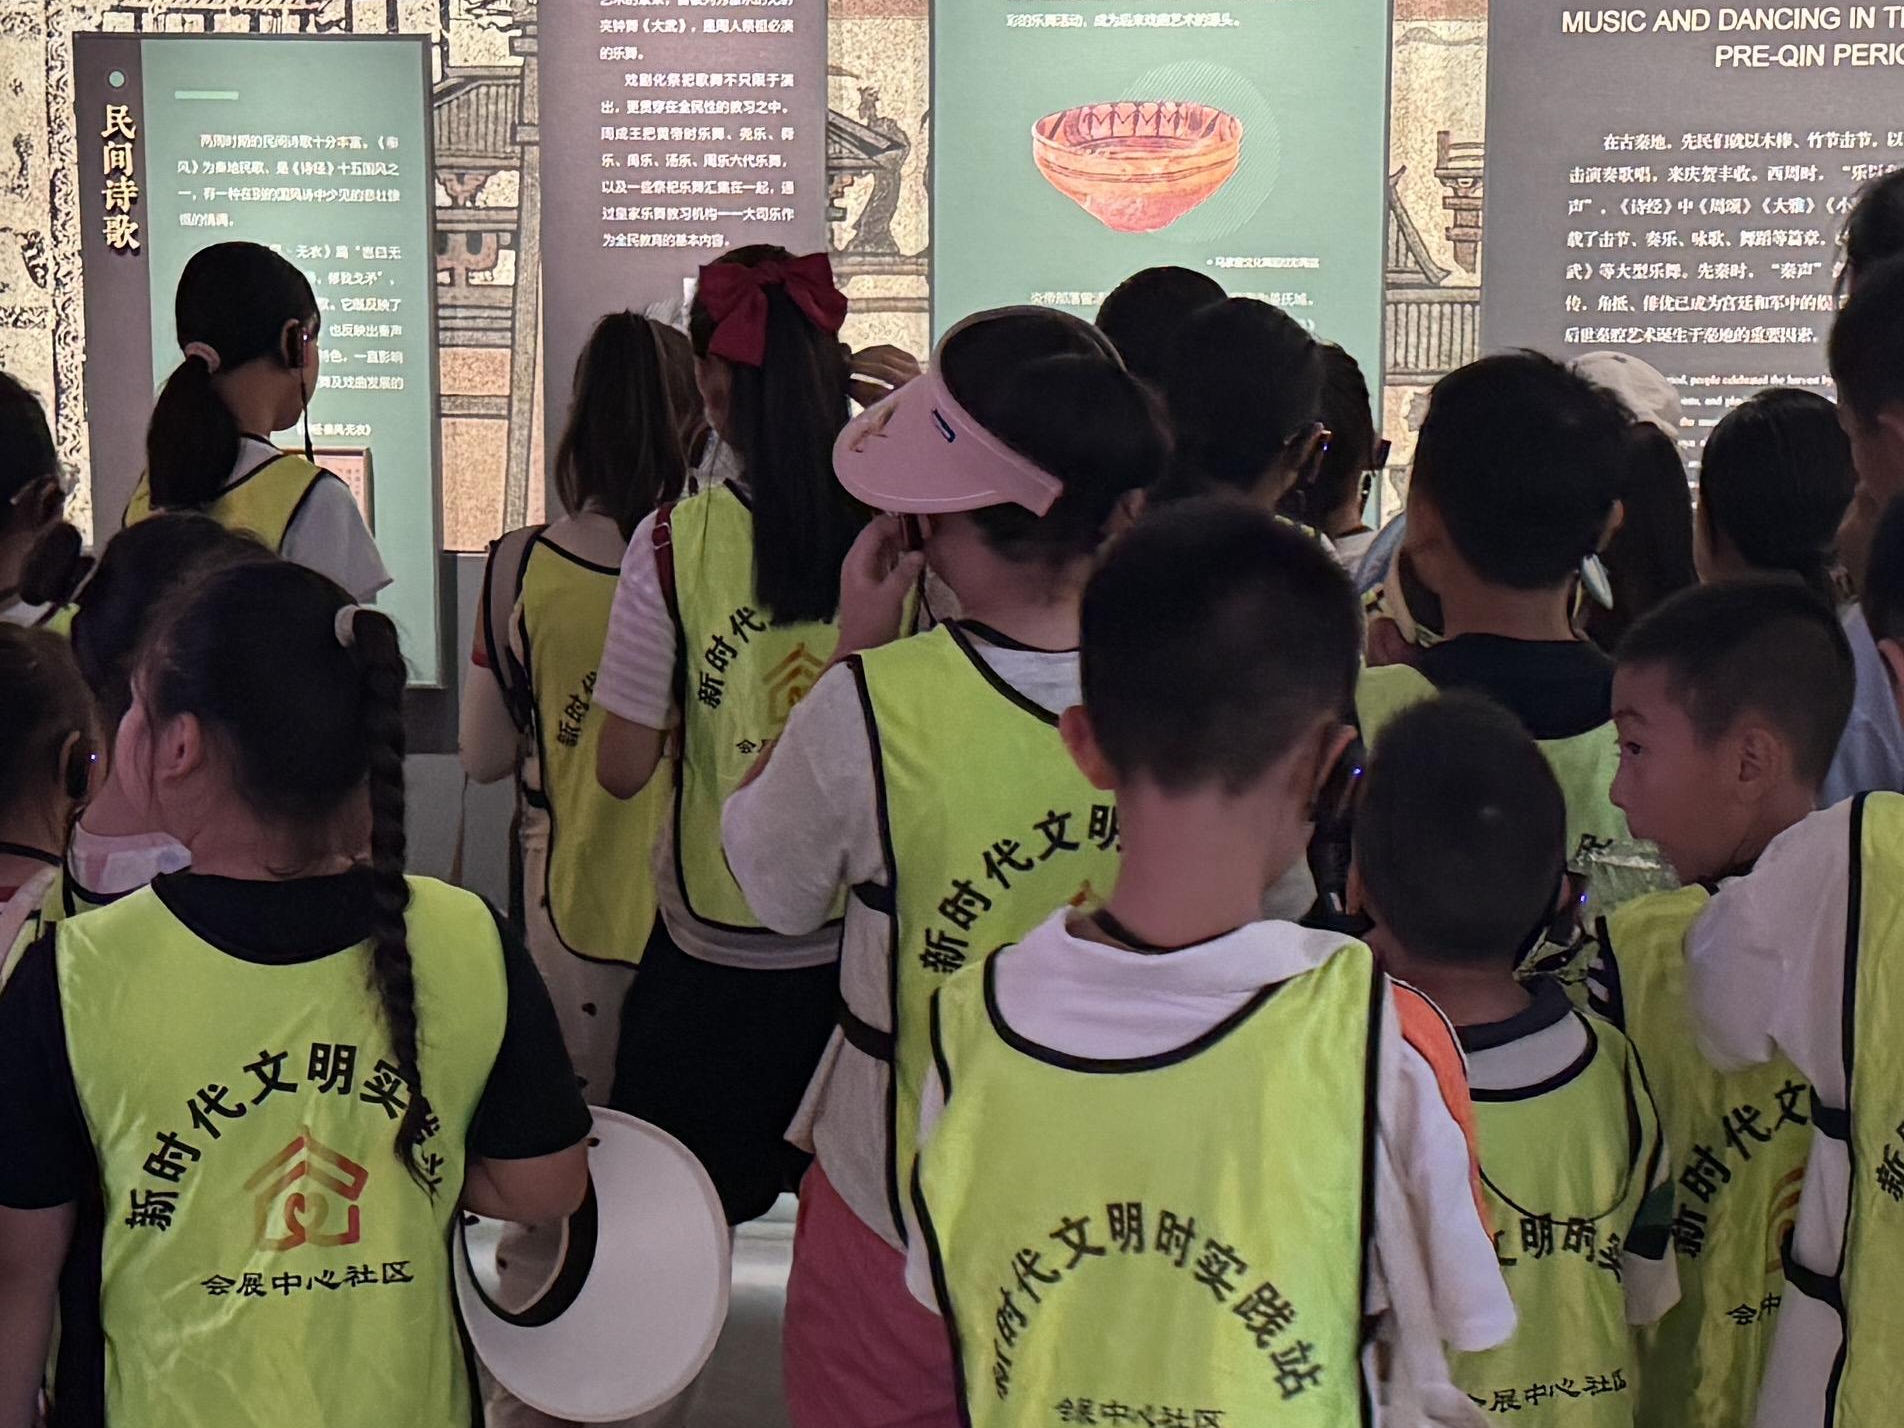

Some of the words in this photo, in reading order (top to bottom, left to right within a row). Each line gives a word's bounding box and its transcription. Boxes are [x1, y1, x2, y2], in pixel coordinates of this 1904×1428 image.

[1561, 7, 1646, 34] MUSIC
[1652, 7, 1710, 32] AND
[1717, 6, 1841, 31] DANCING
[1849, 6, 1875, 29] IN
[1715, 44, 1824, 68] PRE-QIN
[100, 102, 140, 252] 民间诗歌
[200, 1260, 415, 1298] 会展中心社区
